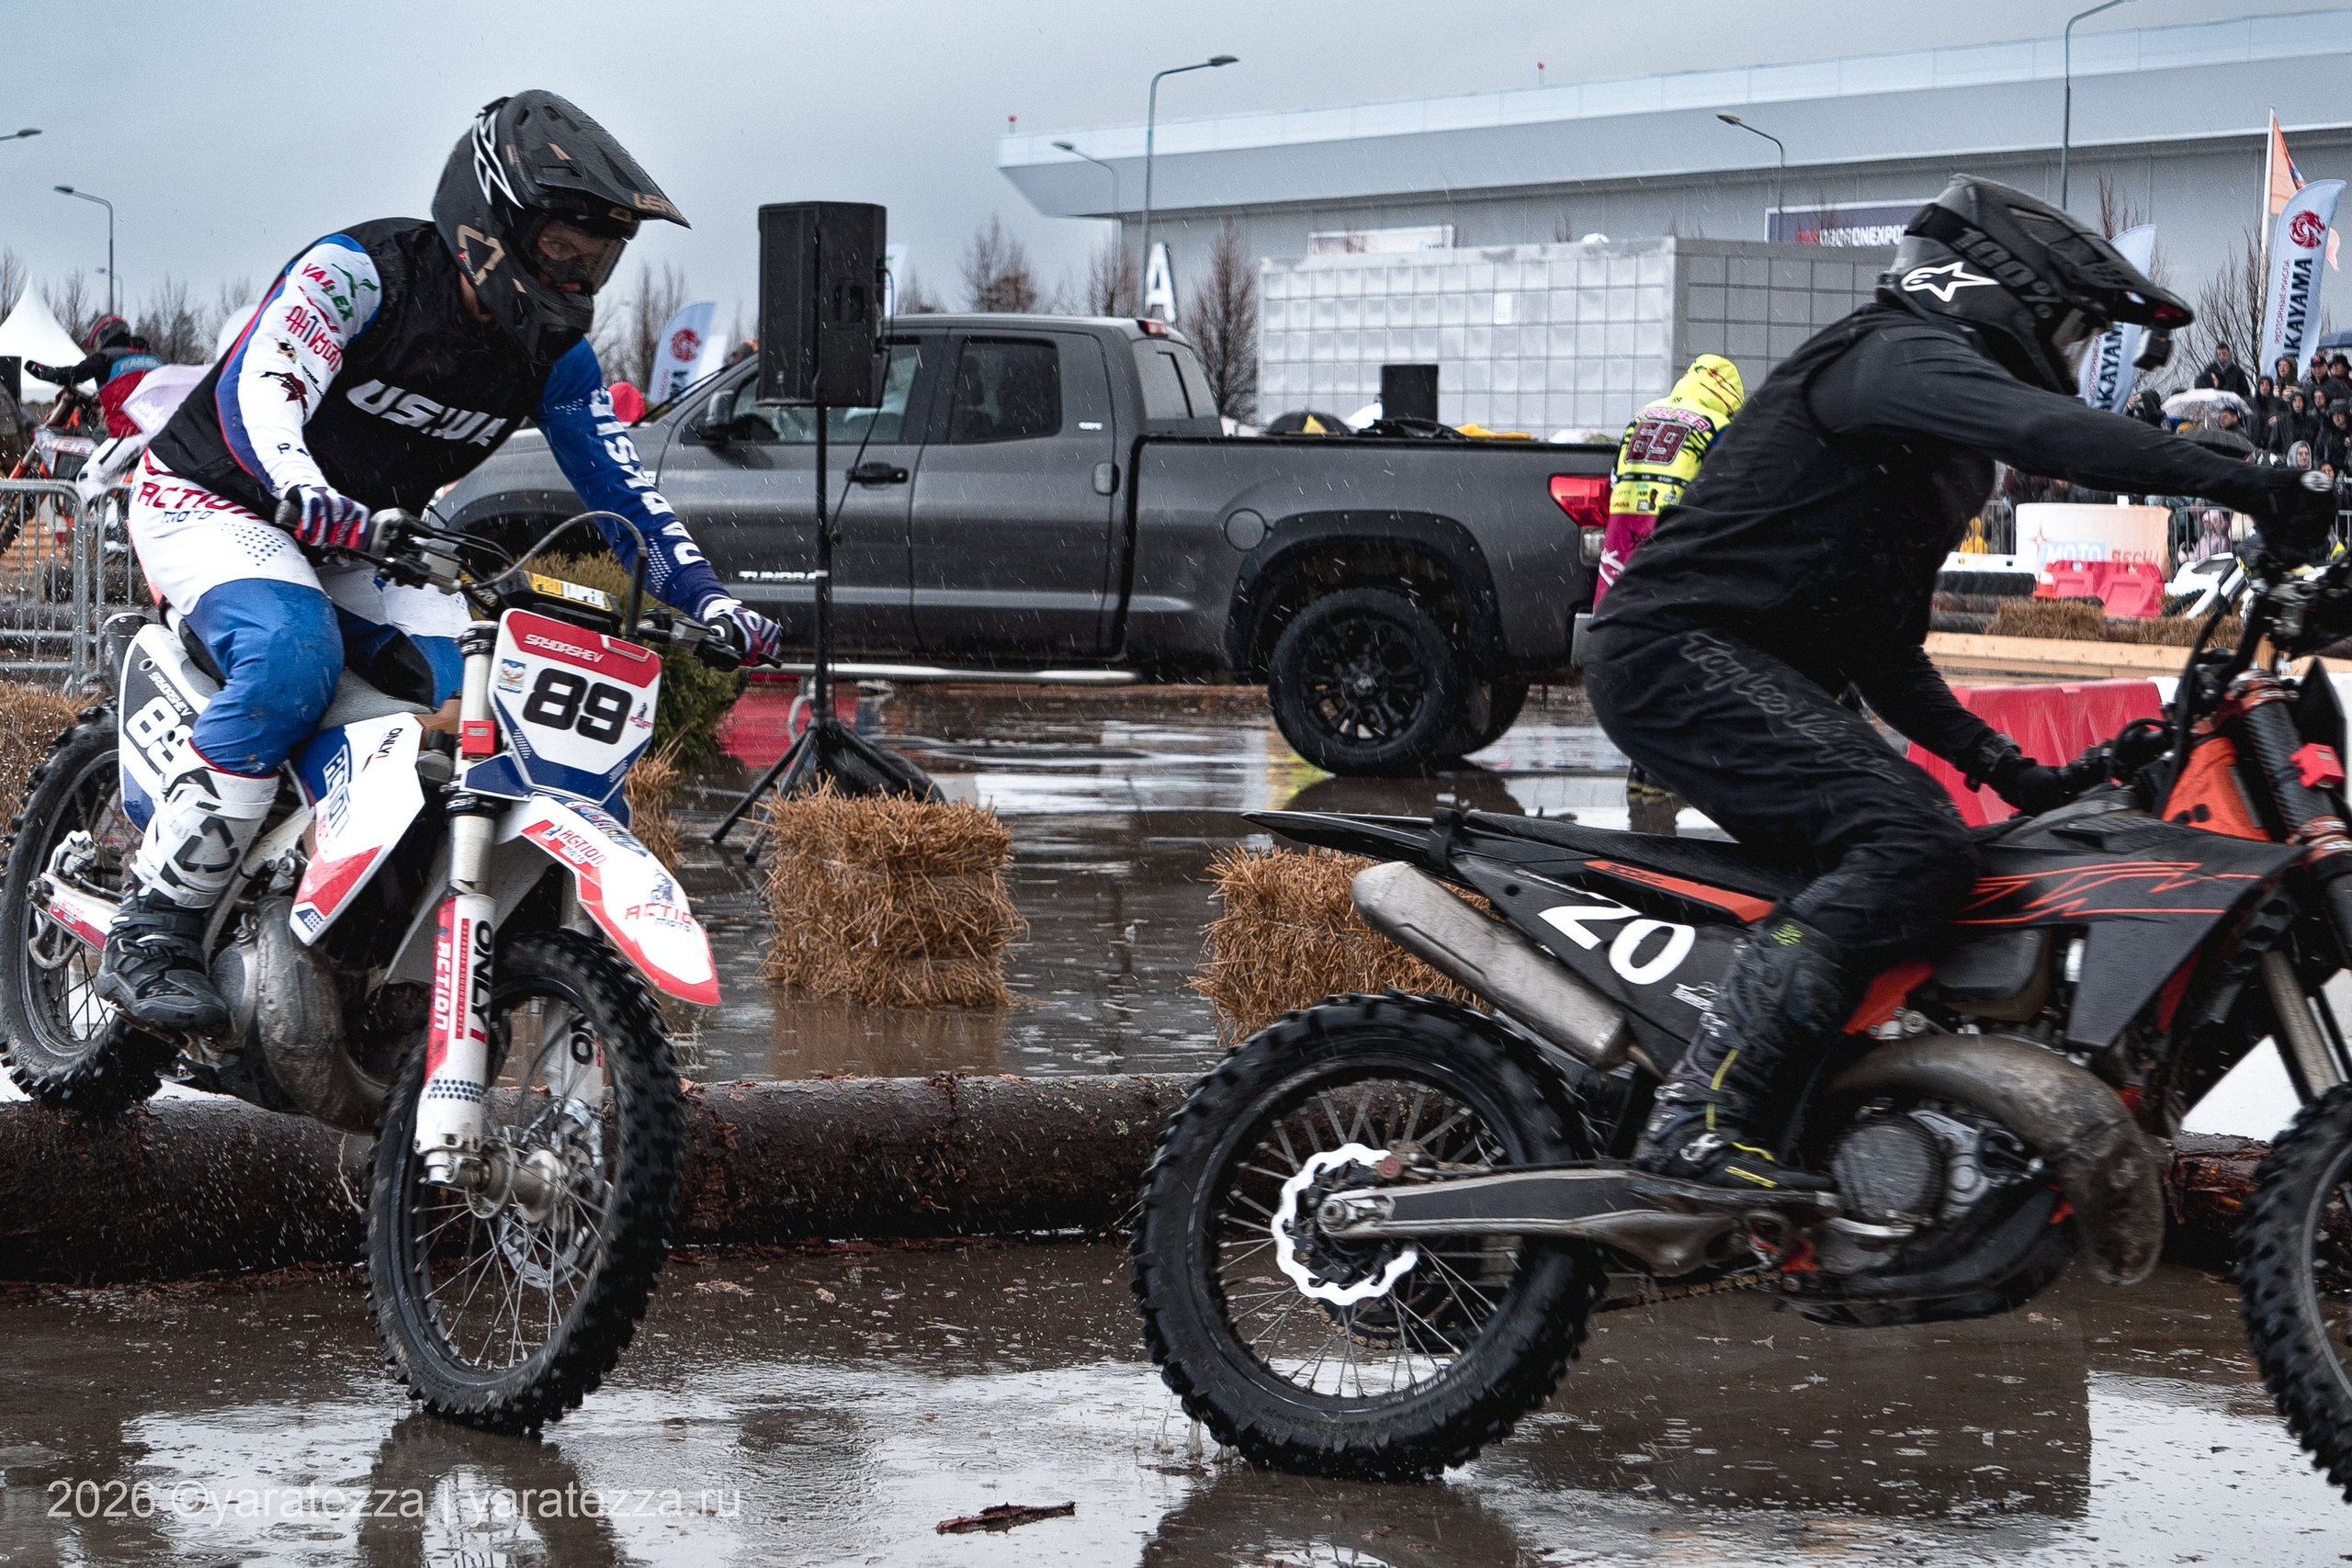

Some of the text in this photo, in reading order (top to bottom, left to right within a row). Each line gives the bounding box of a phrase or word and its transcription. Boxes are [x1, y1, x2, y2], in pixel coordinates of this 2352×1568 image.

[301, 263, 354, 321] VALLEX
[1950, 228, 2064, 320] 100%
[2096, 321, 2124, 411] KAYAM
[522, 667, 633, 745] 89
[434, 941, 454, 1031] ACTION
[1537, 906, 1696, 985] 20
